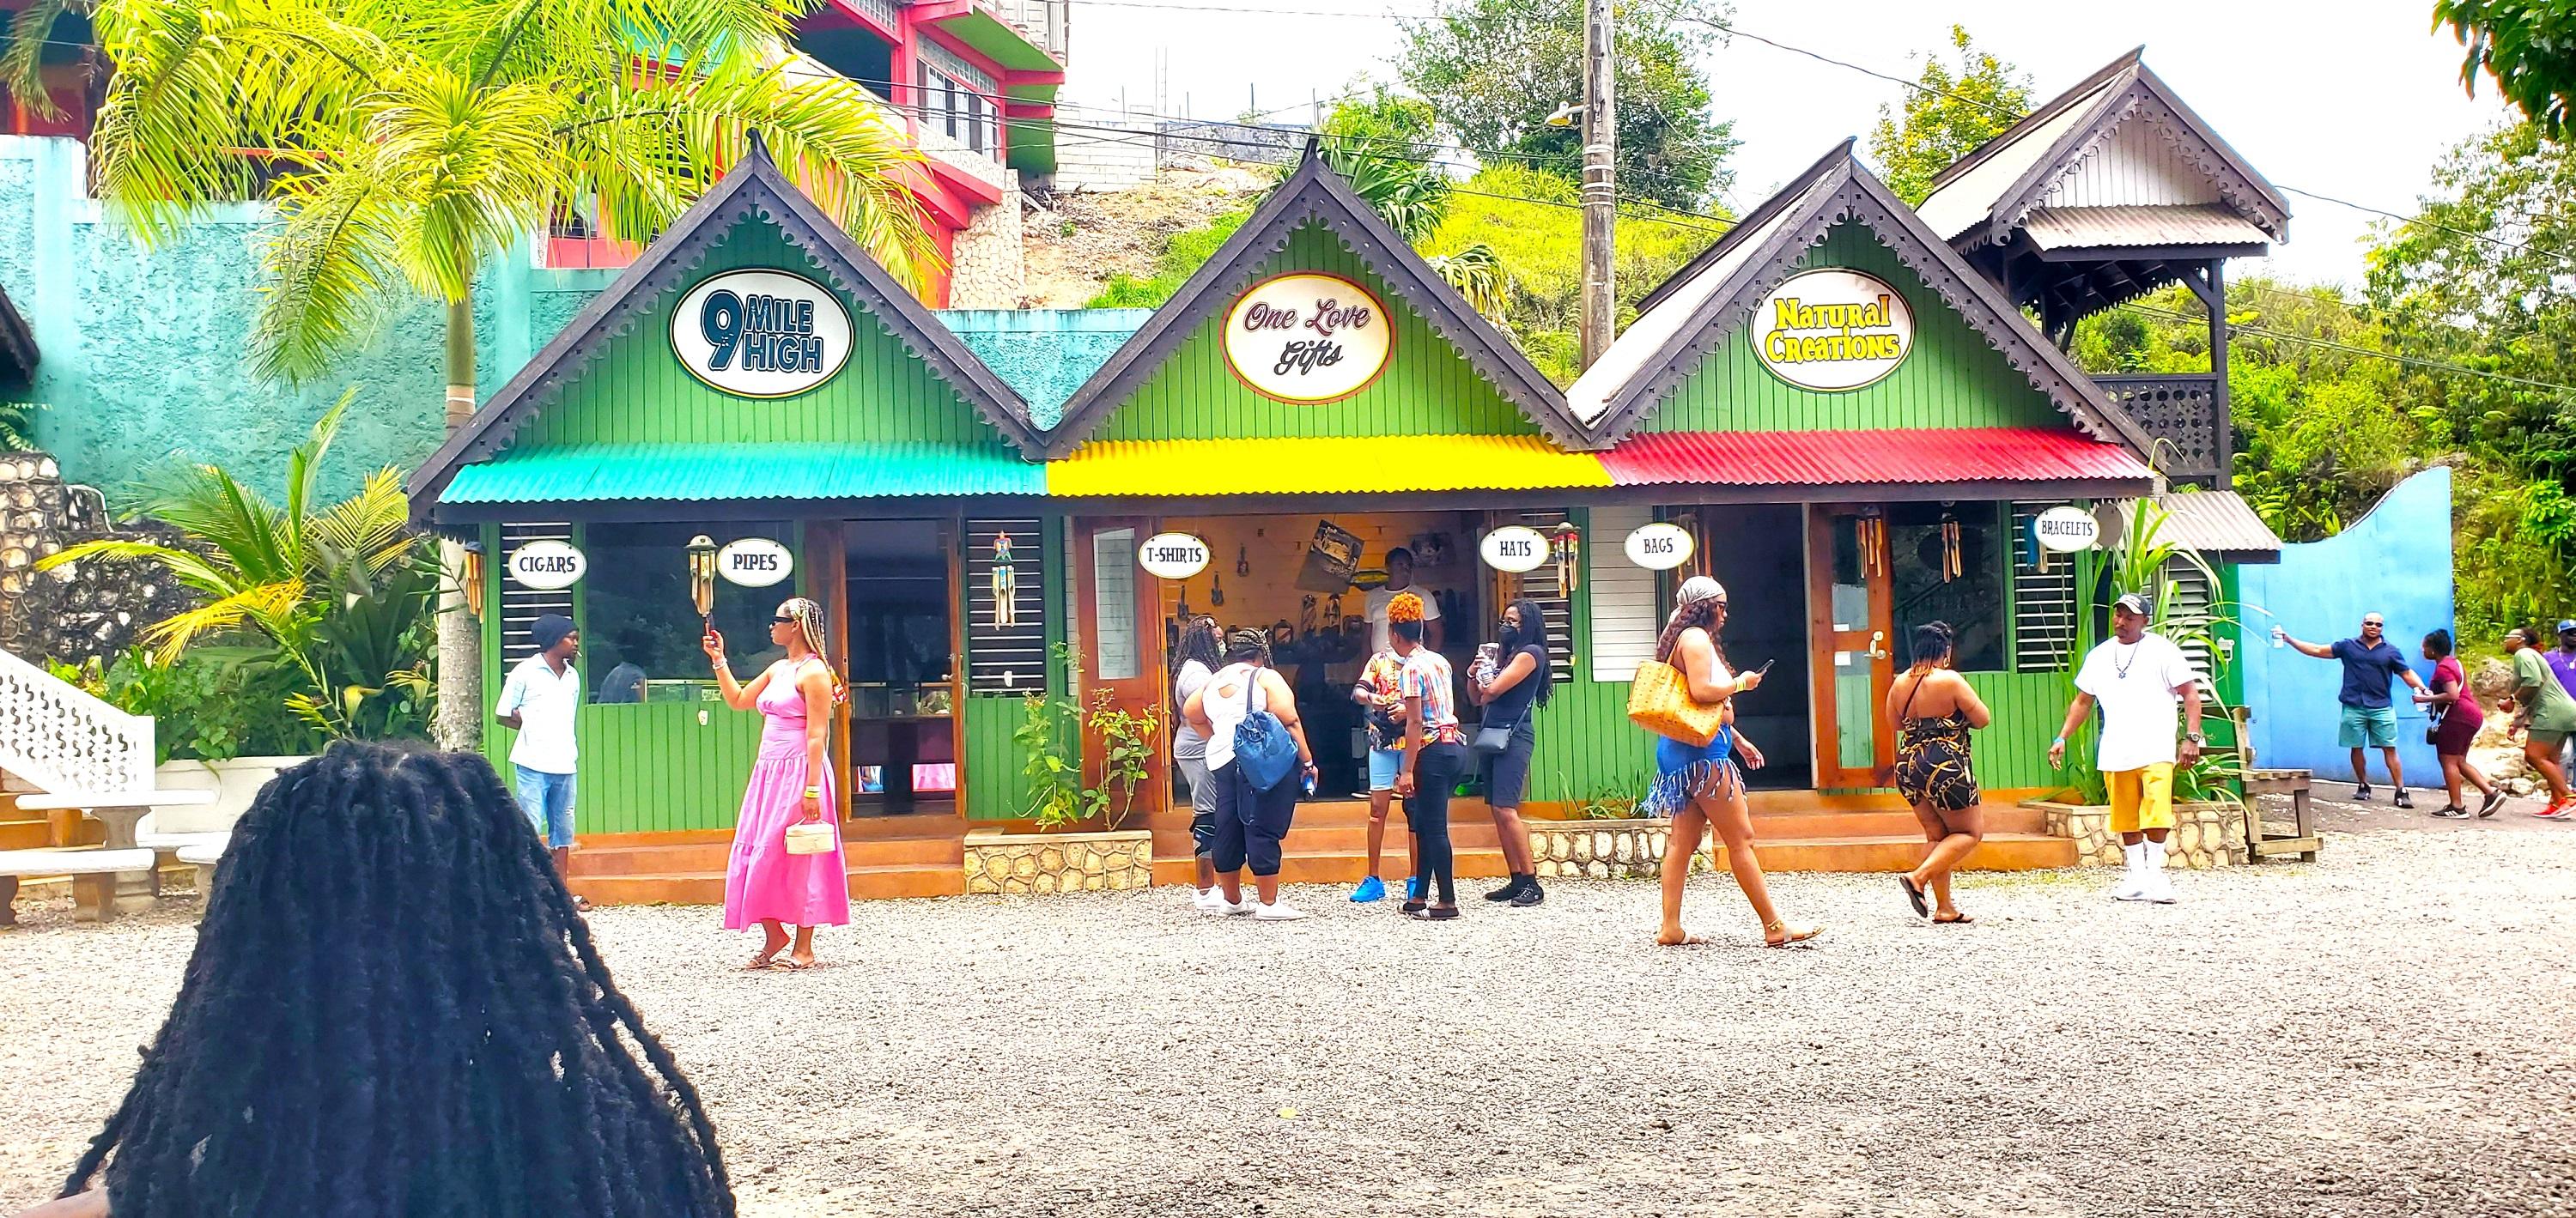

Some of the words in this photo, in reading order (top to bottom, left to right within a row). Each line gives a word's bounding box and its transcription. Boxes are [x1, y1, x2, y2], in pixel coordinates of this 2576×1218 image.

[1243, 301, 1298, 332] One
[1303, 298, 1371, 337] Love
[701, 289, 744, 371] 9
[744, 294, 814, 335] MILE
[742, 332, 823, 373] HIGH
[1273, 339, 1344, 375] Gifts
[2042, 520, 2093, 536] BRACELETS
[1499, 541, 1531, 556] HATS
[1643, 537, 1674, 554] BAGS
[732, 554, 778, 571] PIPES
[1146, 547, 1202, 563] T-SHIRTS
[519, 556, 576, 574] CIGARS
